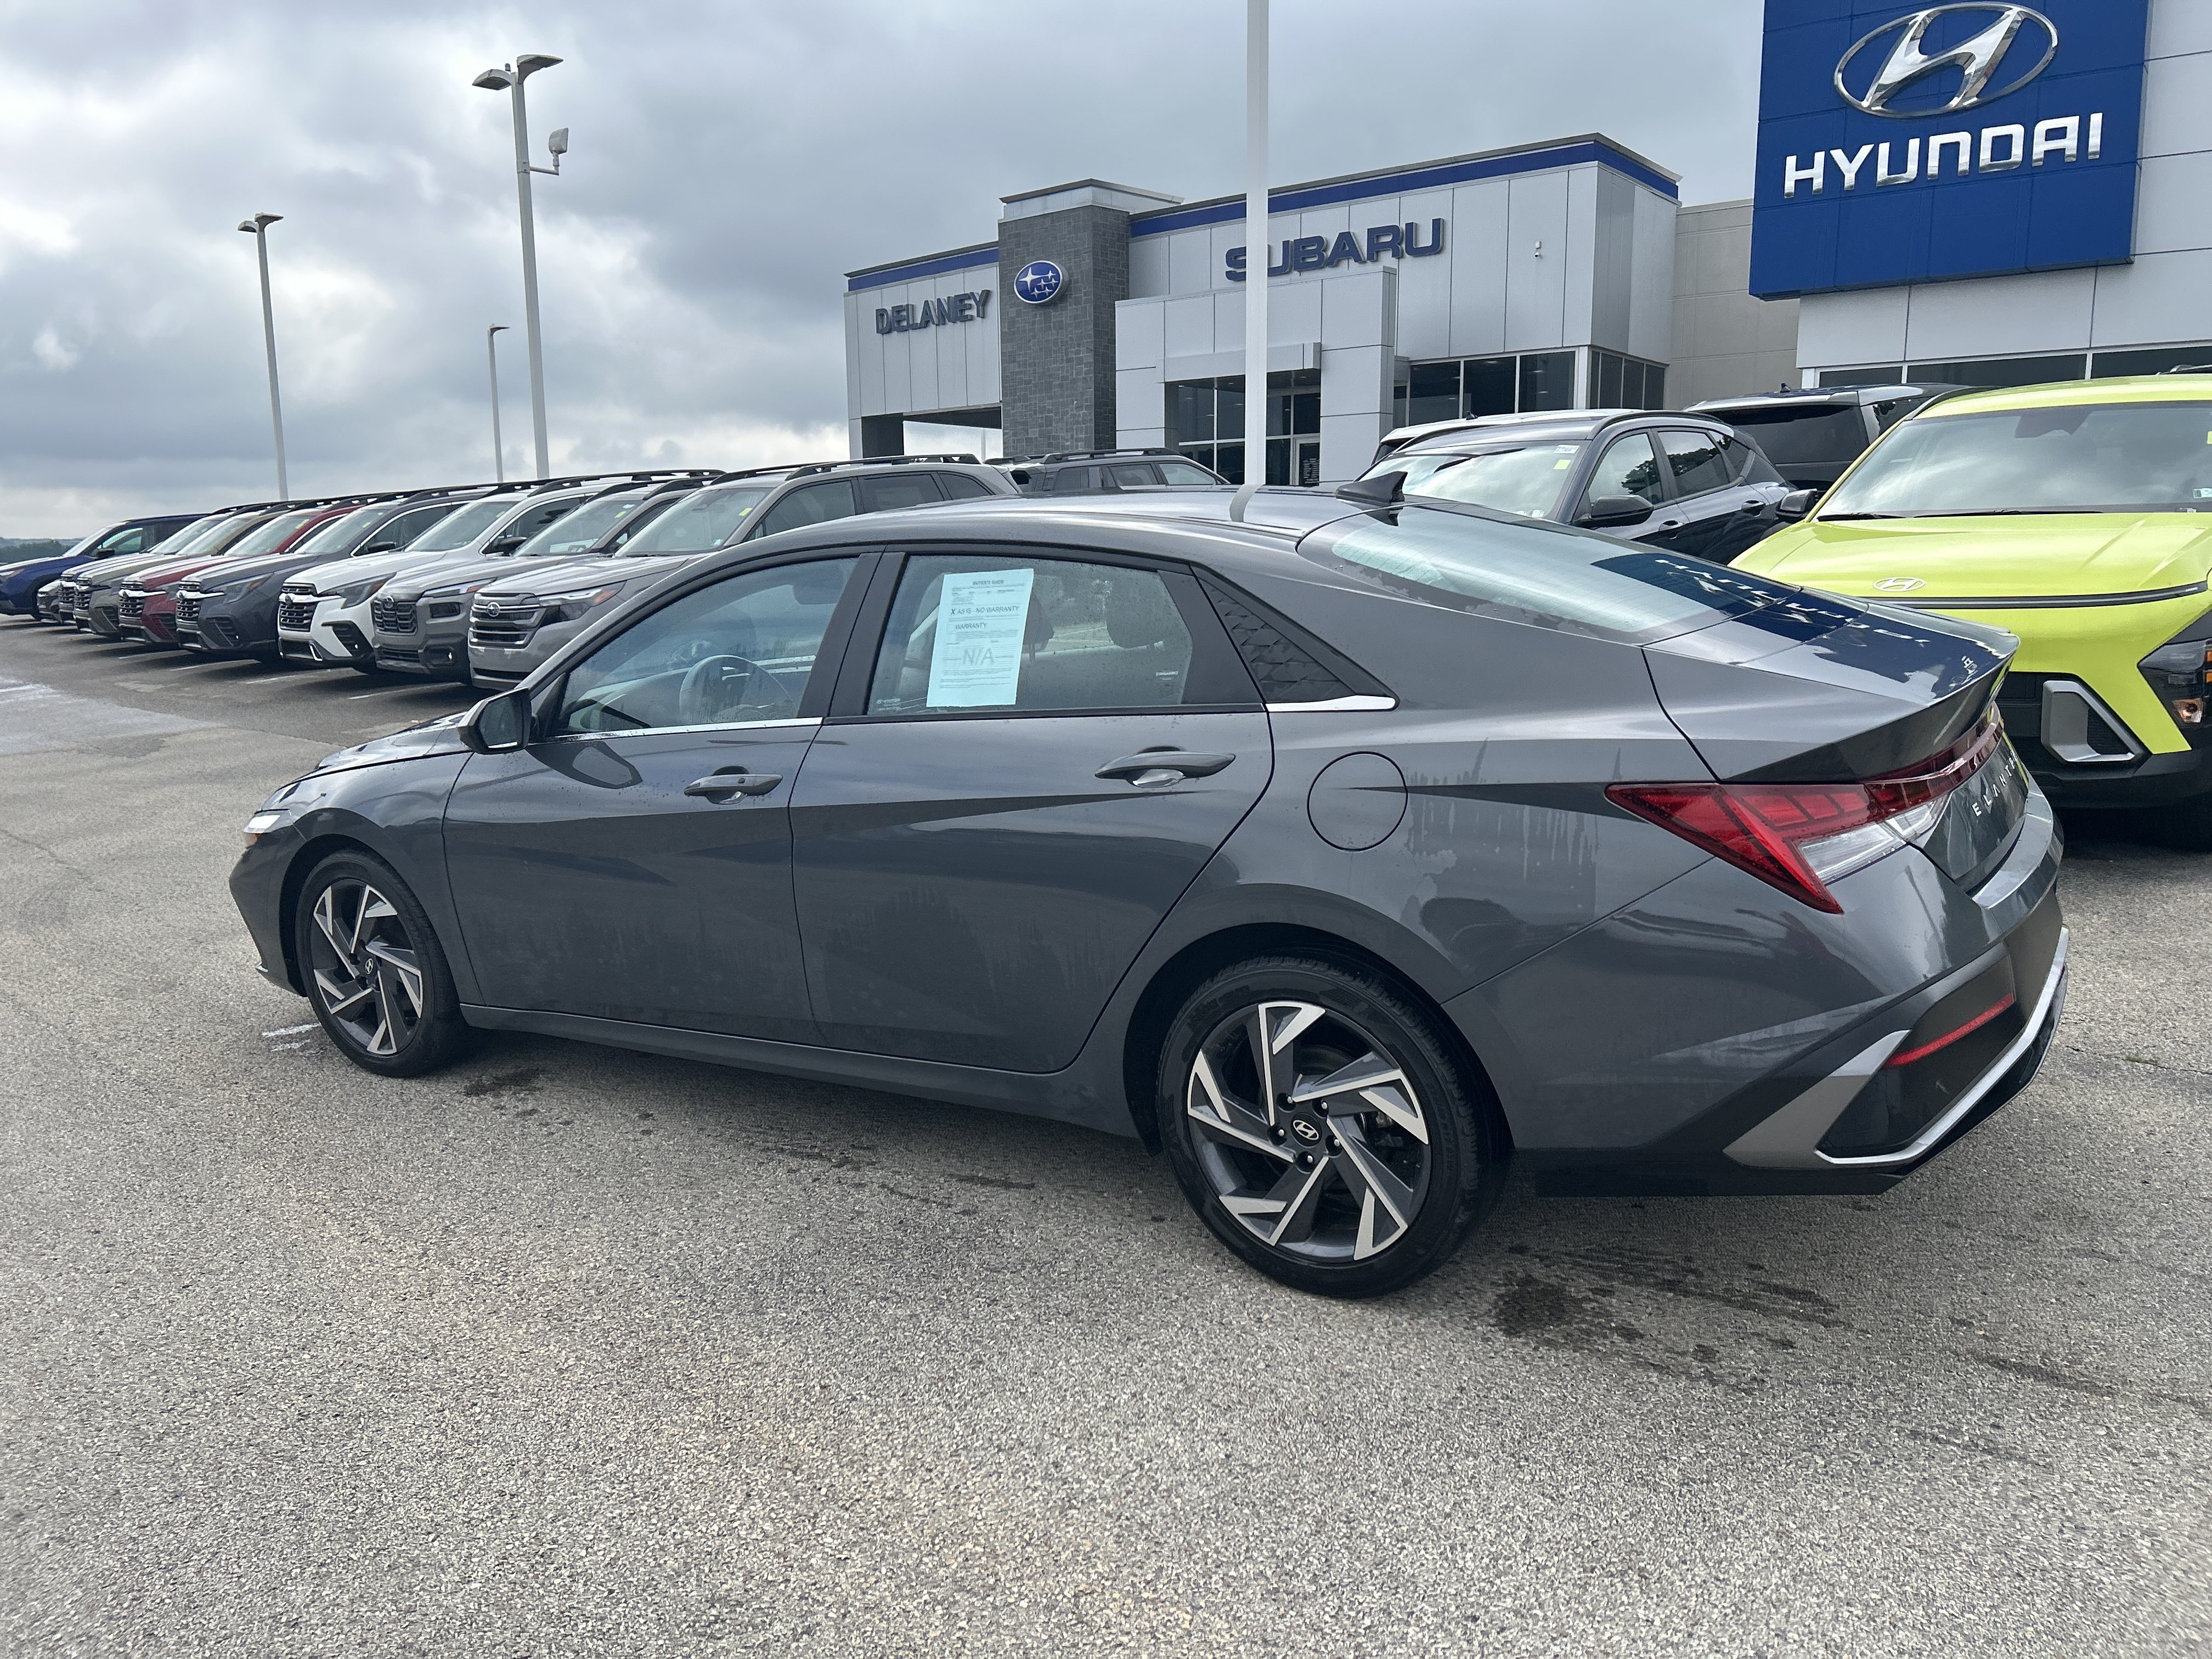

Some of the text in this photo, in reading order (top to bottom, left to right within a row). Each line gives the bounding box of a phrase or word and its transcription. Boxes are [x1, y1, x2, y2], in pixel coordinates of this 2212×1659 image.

[1784, 112, 2103, 199] HYUNDAI
[1224, 218, 1446, 282] SUBARU
[876, 290, 991, 335] DELANEY
